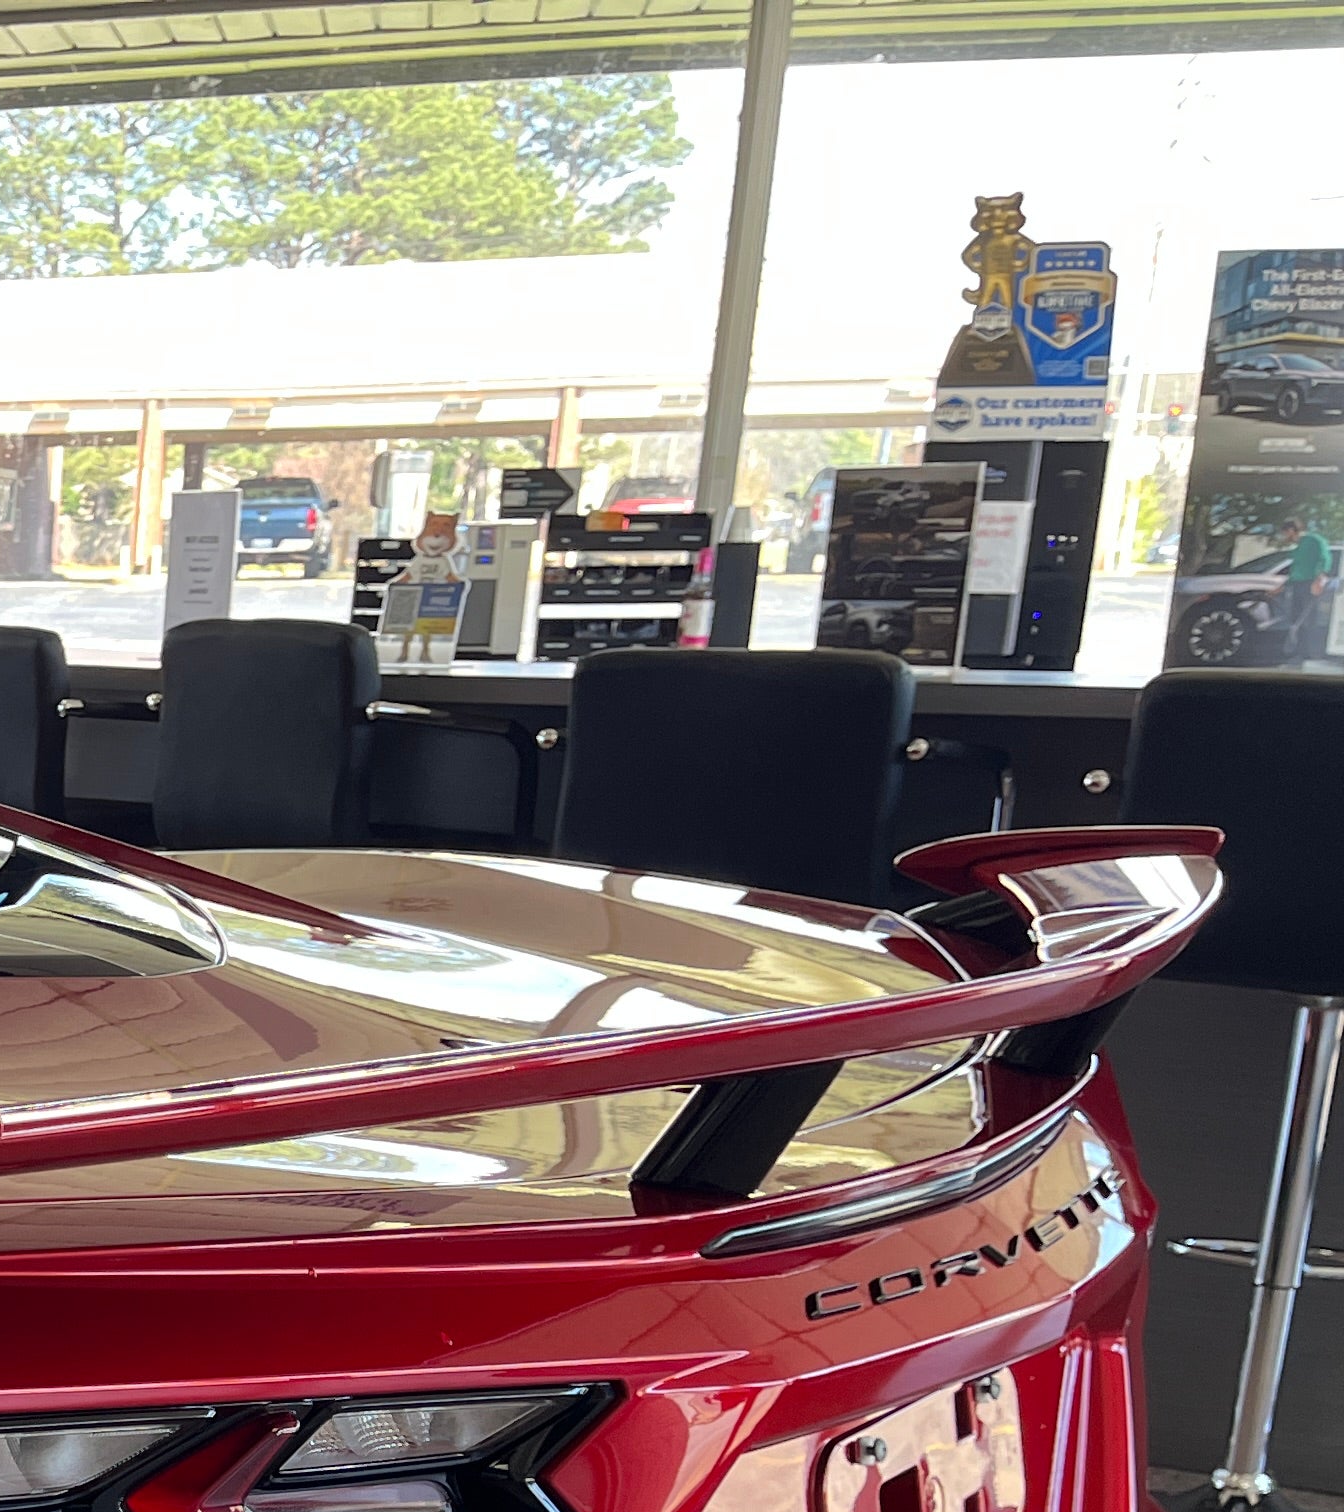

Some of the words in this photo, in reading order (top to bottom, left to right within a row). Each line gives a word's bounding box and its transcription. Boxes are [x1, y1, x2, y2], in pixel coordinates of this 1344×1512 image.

[1261, 268, 1290, 282] The
[1251, 298, 1298, 313] Chevy
[976, 397, 1009, 409] Our
[1013, 397, 1104, 409] customers
[980, 414, 1023, 426] have
[1028, 412, 1097, 429] spoken!
[804, 1165, 1127, 1321] CORVETTE
